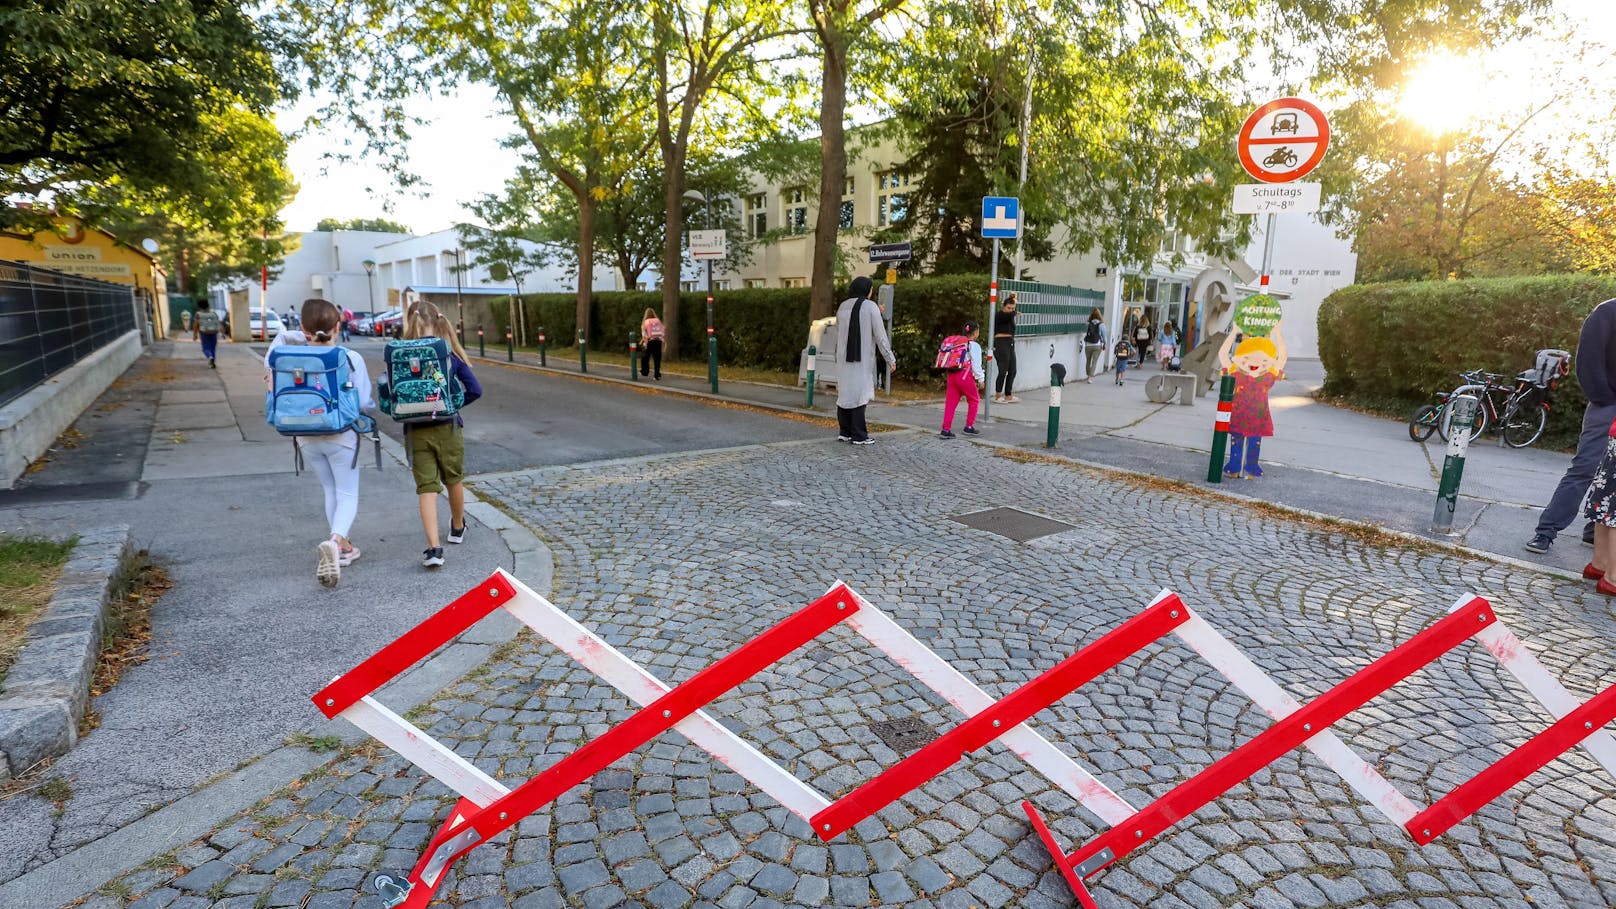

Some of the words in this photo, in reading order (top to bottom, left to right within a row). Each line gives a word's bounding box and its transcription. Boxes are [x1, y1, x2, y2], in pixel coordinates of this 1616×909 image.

[1252, 187, 1302, 198] Schultags
[51, 252, 95, 260] union
[1241, 305, 1282, 315] ACHTUNG
[1243, 316, 1279, 327] KINDER
